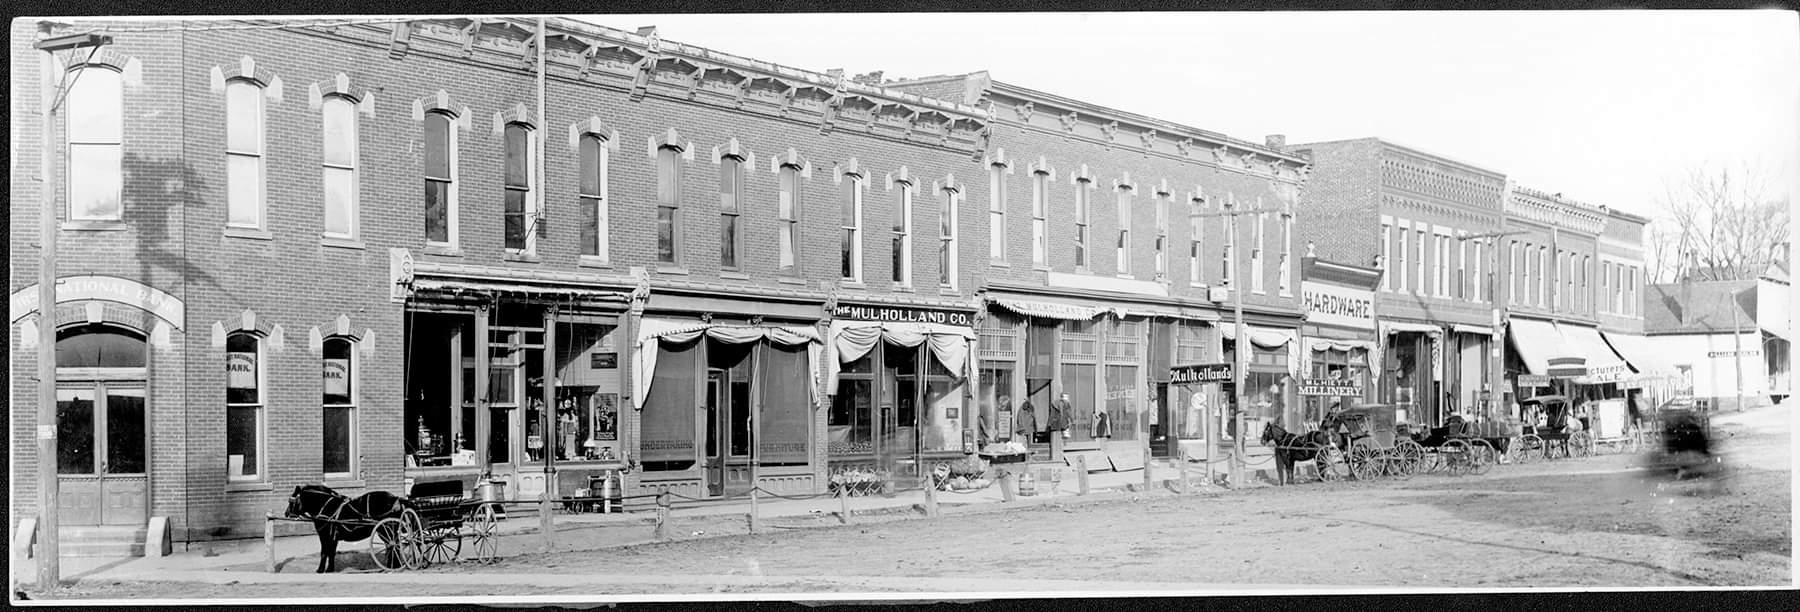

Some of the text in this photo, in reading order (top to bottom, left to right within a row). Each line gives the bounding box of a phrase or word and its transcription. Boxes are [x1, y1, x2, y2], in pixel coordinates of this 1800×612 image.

[832, 306, 971, 325] THE MULHOLLAND CO.
[1298, 386, 1362, 396] MILLINERY
